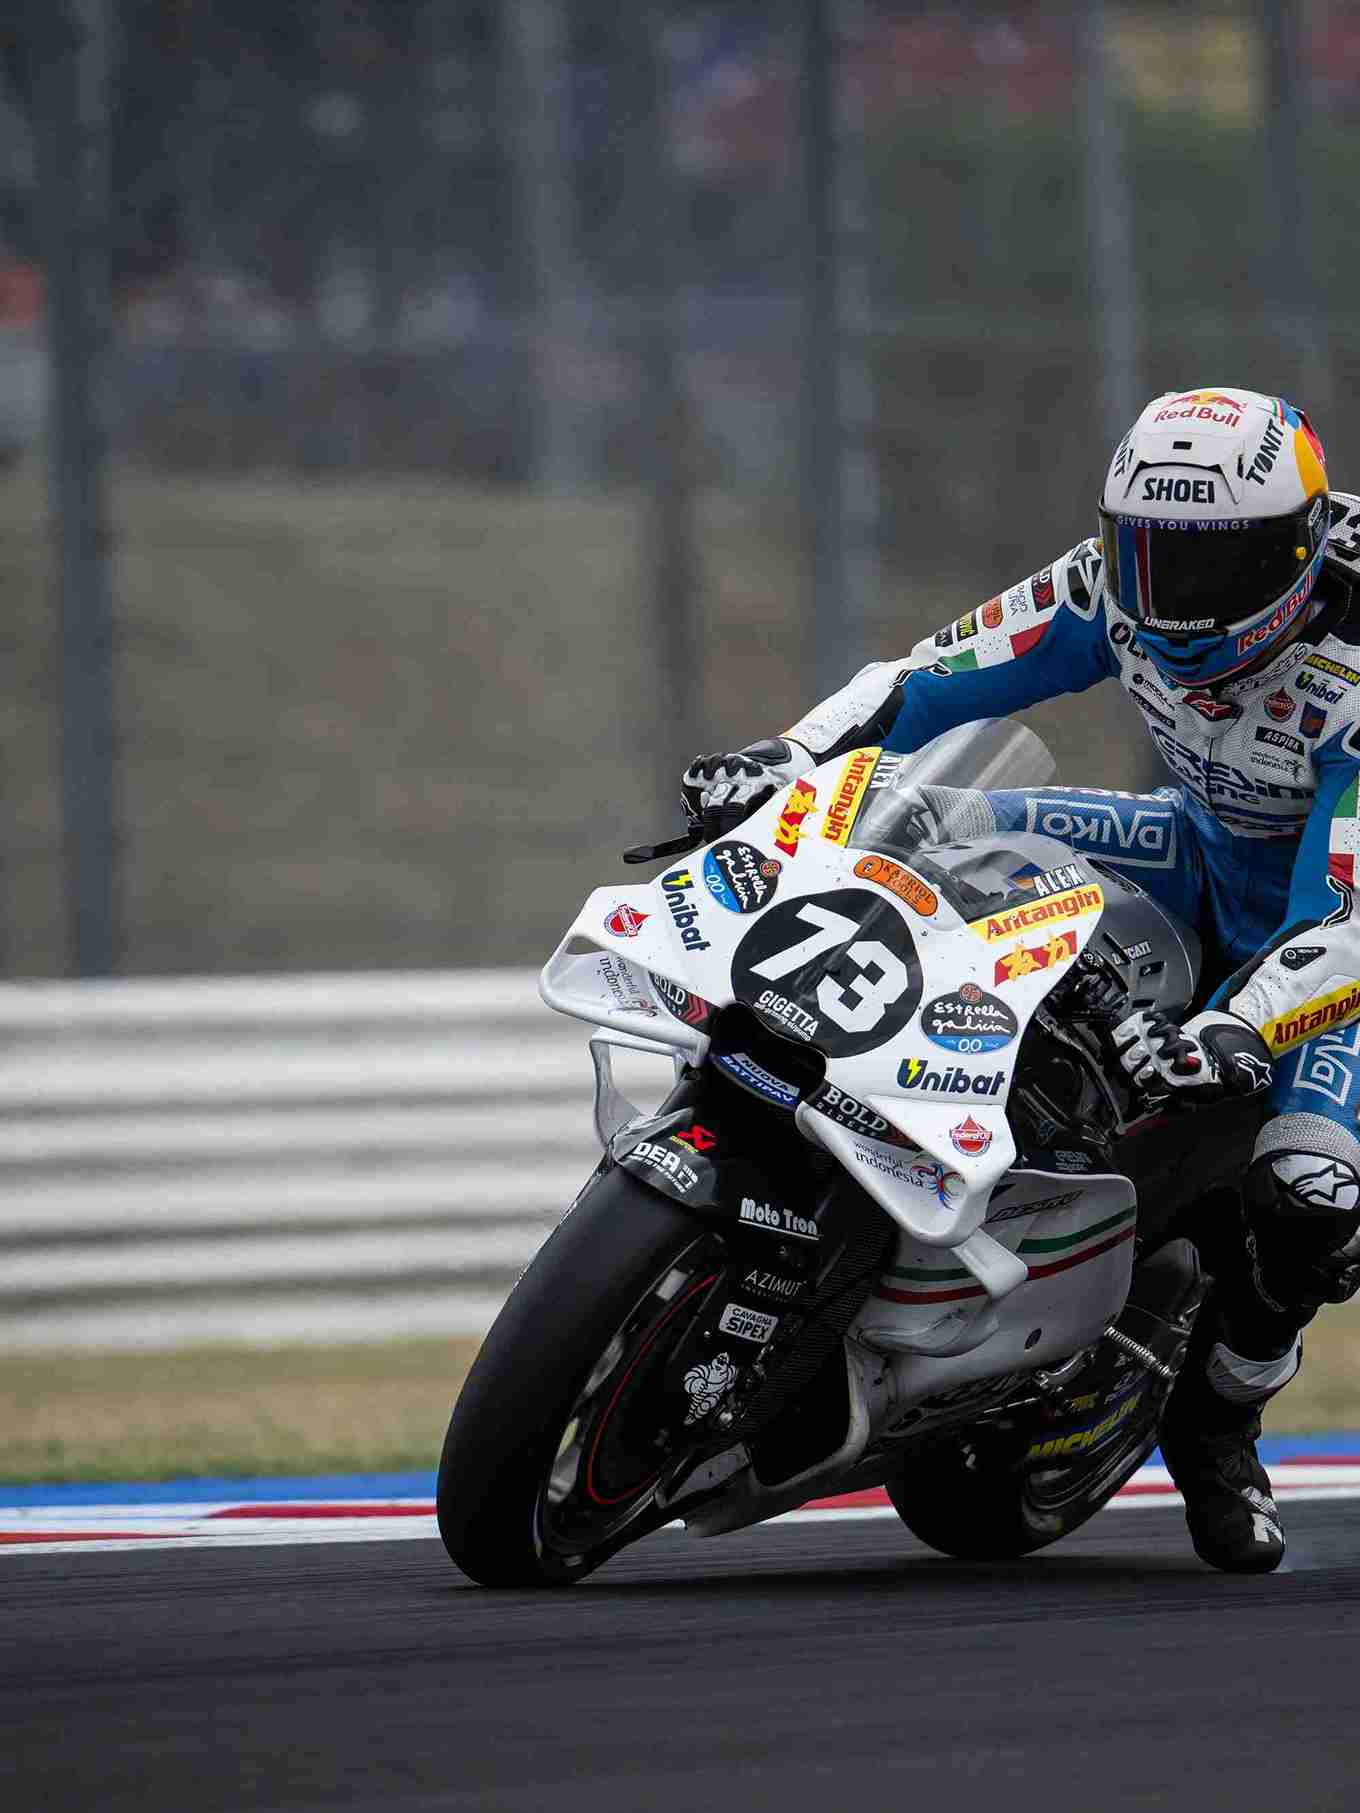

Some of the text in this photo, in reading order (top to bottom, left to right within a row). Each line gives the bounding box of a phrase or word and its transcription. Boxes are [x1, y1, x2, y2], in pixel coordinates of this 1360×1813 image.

[1154, 406, 1241, 428] Red Bull
[1142, 477, 1215, 504] SHOEI
[1116, 515, 1249, 532] GIVES YOU WINGS
[1237, 607, 1284, 656] Red
[823, 751, 875, 842] Antangin
[1033, 863, 1085, 897] ALEX
[661, 869, 712, 952] Unibat
[986, 889, 1102, 940] Antangin
[750, 903, 908, 1033] 73
[759, 989, 819, 1037] GIGETTA
[897, 1057, 1006, 1096] Unibat
[822, 1086, 888, 1131] BOLD
[740, 1198, 818, 1235] Moto Tron
[744, 1269, 807, 1297] AZIMUT
[725, 1317, 770, 1340] SIPEX
